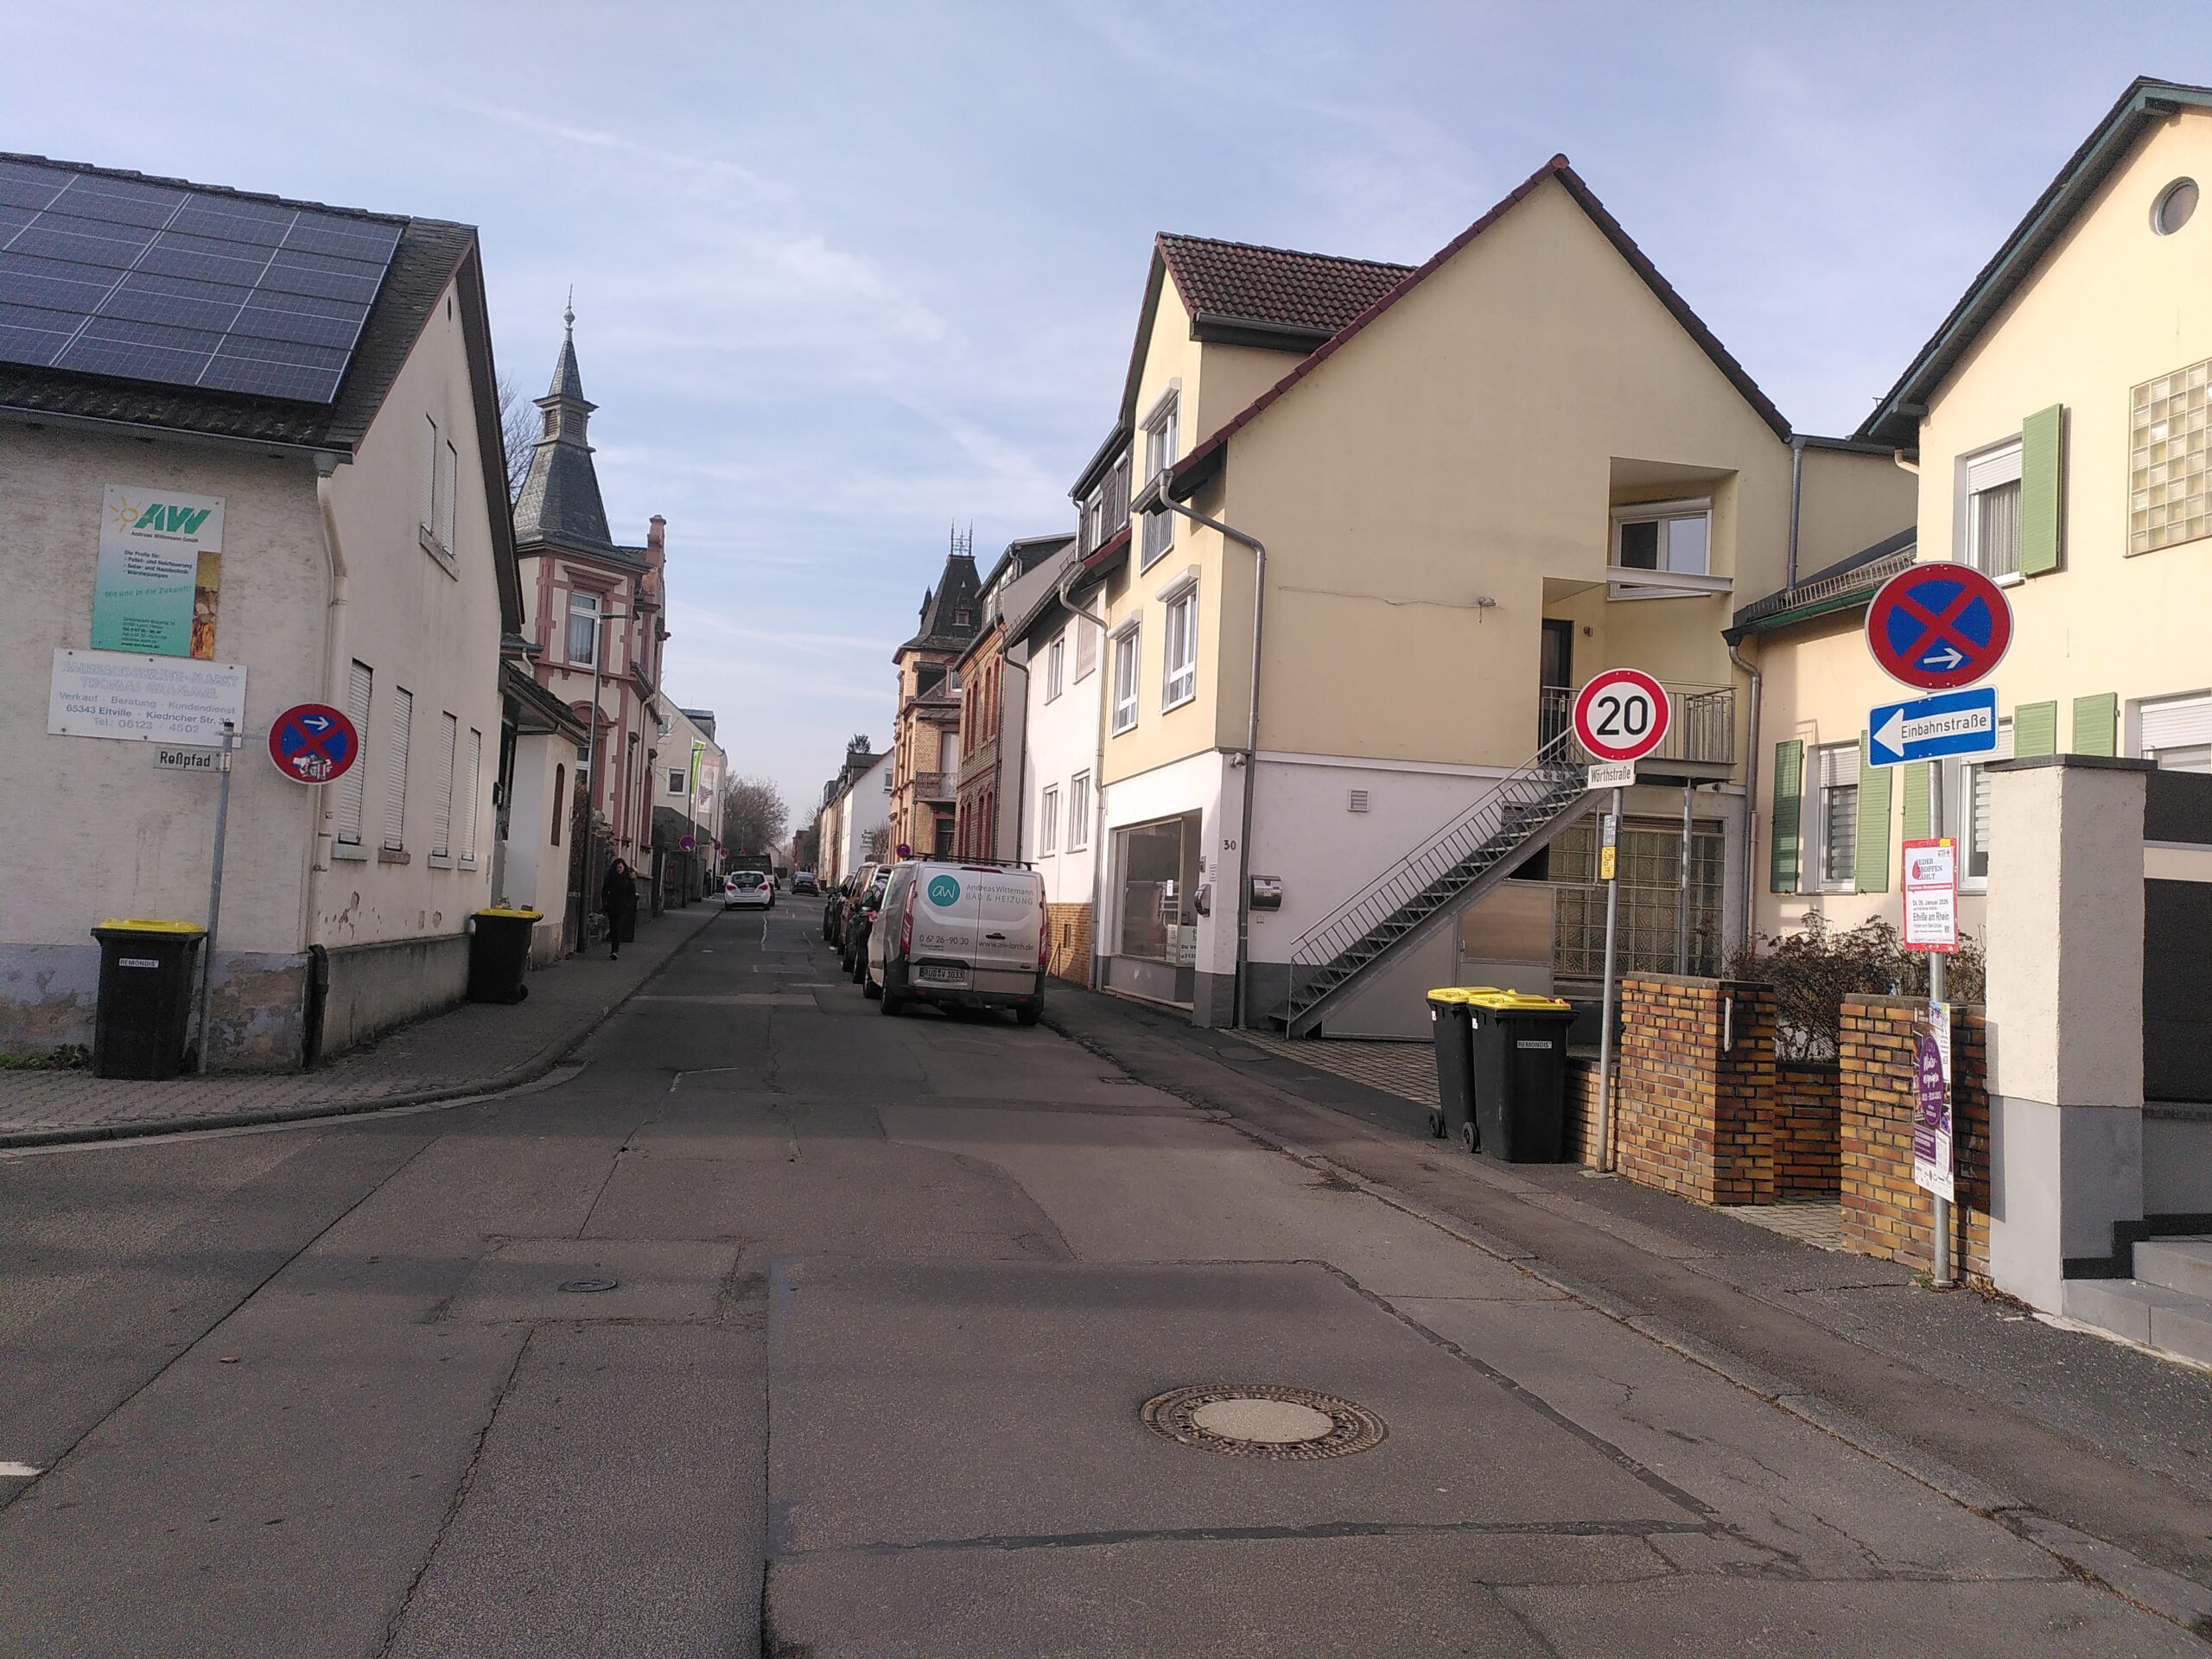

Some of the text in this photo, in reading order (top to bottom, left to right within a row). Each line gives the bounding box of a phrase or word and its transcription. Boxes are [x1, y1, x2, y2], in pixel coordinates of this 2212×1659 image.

[133, 504, 212, 534] AW
[60, 691, 236, 715] Verkauf Beratung Kundendienst
[66, 704, 96, 715] 65343
[99, 707, 131, 717] Eltville
[146, 711, 198, 723] Kiedricher
[200, 715, 216, 724] Str.
[1597, 696, 1648, 735] 20
[169, 723, 200, 734] 4502
[1901, 714, 1987, 739] Einbahnstraße
[160, 751, 211, 768] Roßpfad
[1591, 766, 1631, 783] Wörthstraße
[1224, 840, 1236, 850] 30
[966, 884, 1033, 896] Andreas Wittemann
[995, 895, 1033, 905] HEIZUNG
[1913, 912, 1928, 921] Eltville
[1936, 912, 1950, 921] Rhein
[978, 941, 1033, 950] www.aw-lorch.de
